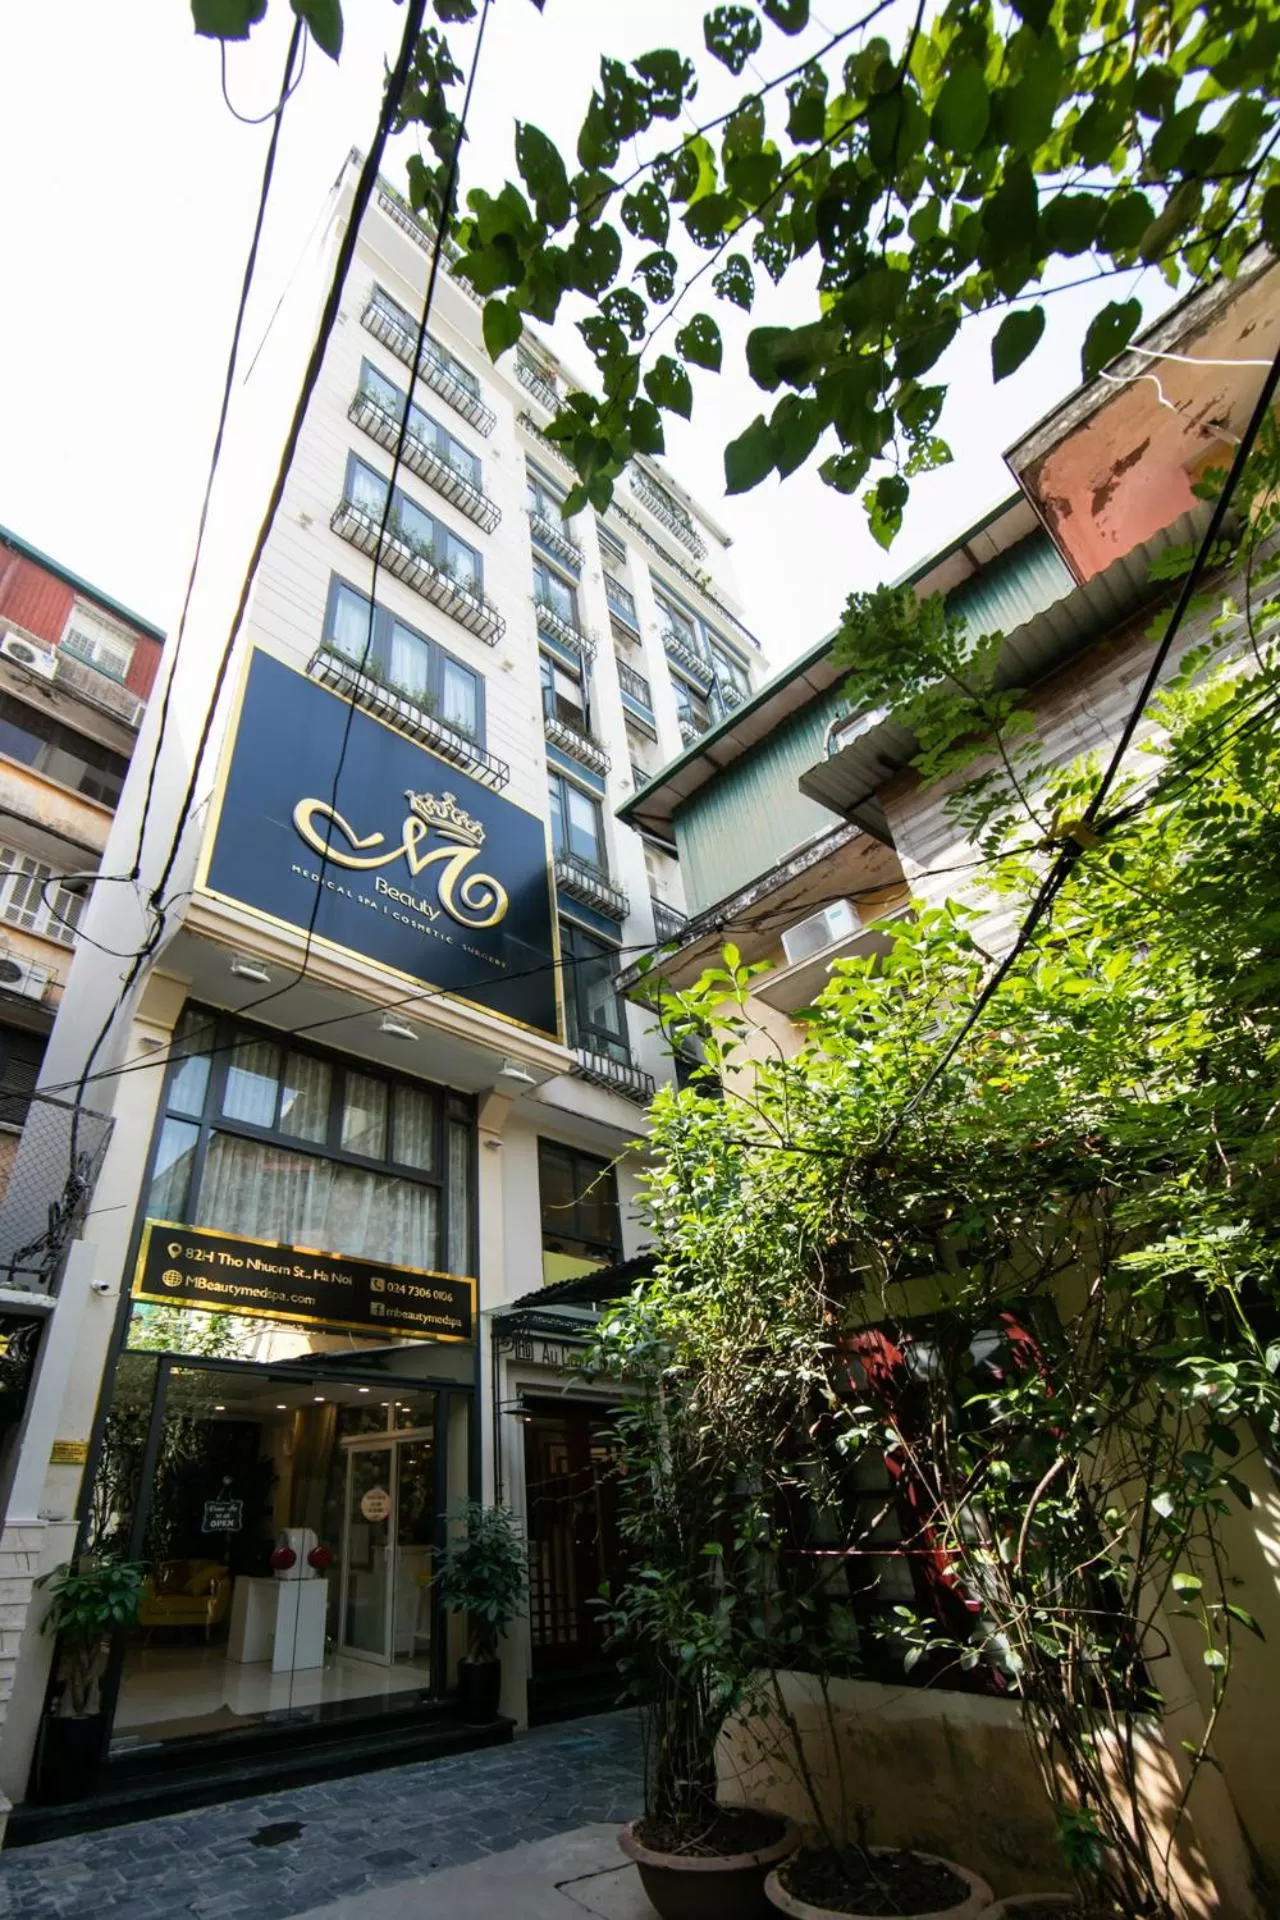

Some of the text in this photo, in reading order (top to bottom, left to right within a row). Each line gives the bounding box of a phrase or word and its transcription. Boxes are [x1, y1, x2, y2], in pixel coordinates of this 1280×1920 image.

[374, 876, 441, 921] Beauty
[291, 864, 353, 898] MEDICAL
[357, 895, 378, 910] SPA
[392, 911, 454, 944] COSMETIC
[461, 943, 508, 969] SURGERY
[185, 1247, 215, 1264] 82H
[217, 1252, 244, 1268] Tho
[246, 1257, 291, 1276] Nhuom
[313, 1268, 329, 1282] Ha
[331, 1272, 353, 1286] Noi
[184, 1274, 316, 1306] MBeautymedspa.com
[386, 1281, 406, 1295] 024
[408, 1285, 432, 1300] 7306
[385, 1306, 463, 1329] mbeautymedspa
[210, 1519, 234, 1528] OPEN
